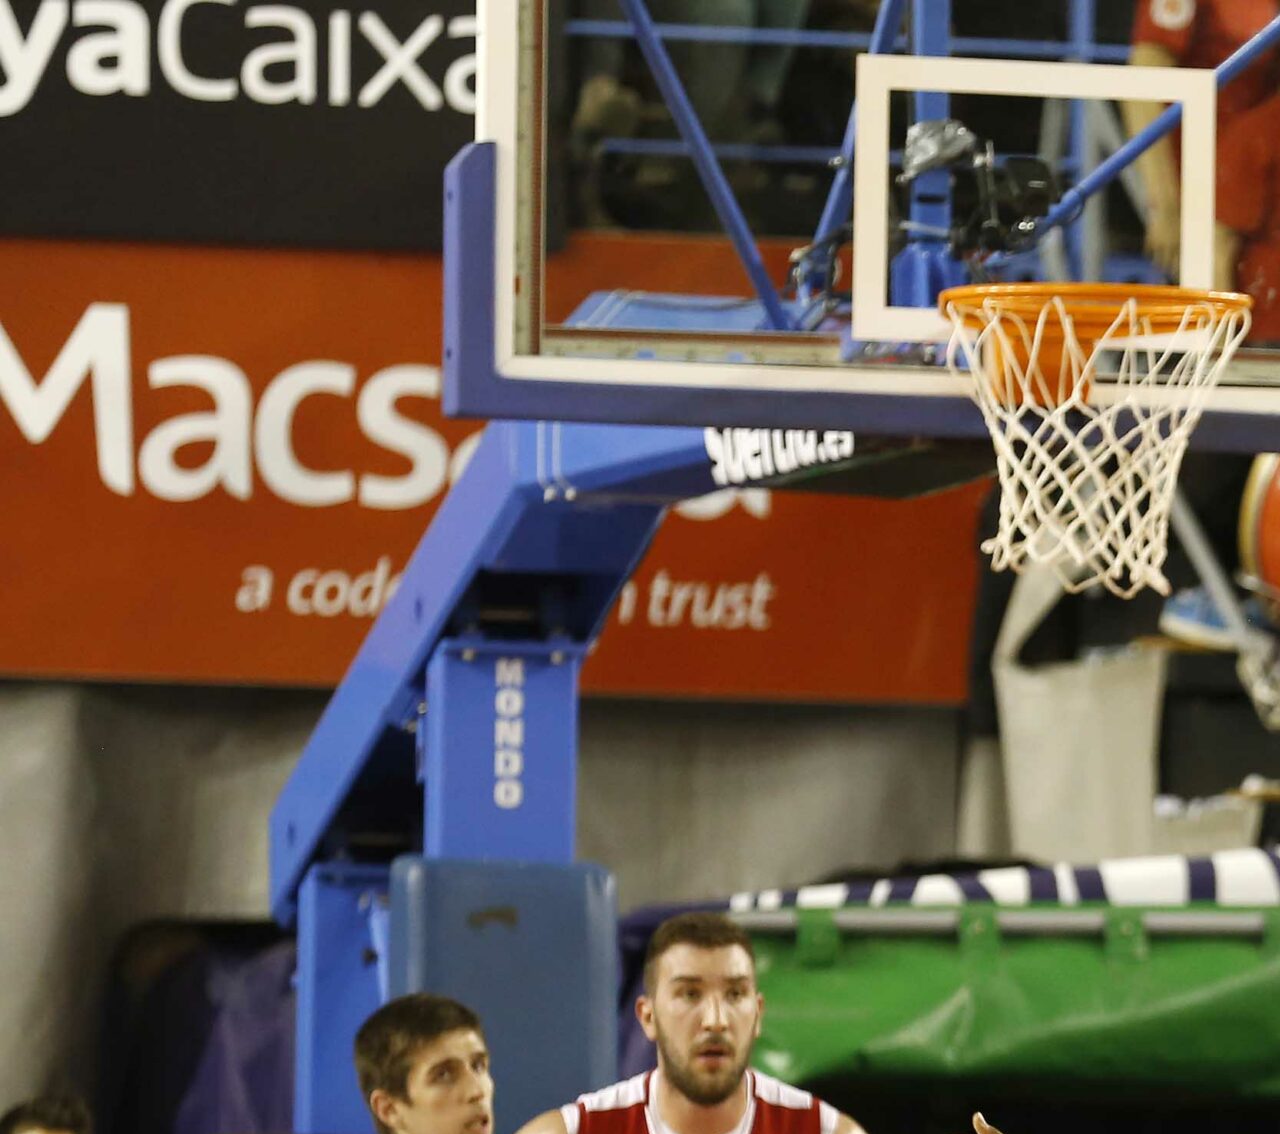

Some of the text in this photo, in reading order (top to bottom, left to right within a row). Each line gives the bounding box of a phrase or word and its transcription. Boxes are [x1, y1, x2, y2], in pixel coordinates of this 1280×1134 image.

[0, 301, 480, 512] Macs
[235, 564, 273, 613] a
[647, 569, 774, 632] trust
[494, 657, 525, 810] MONDO
